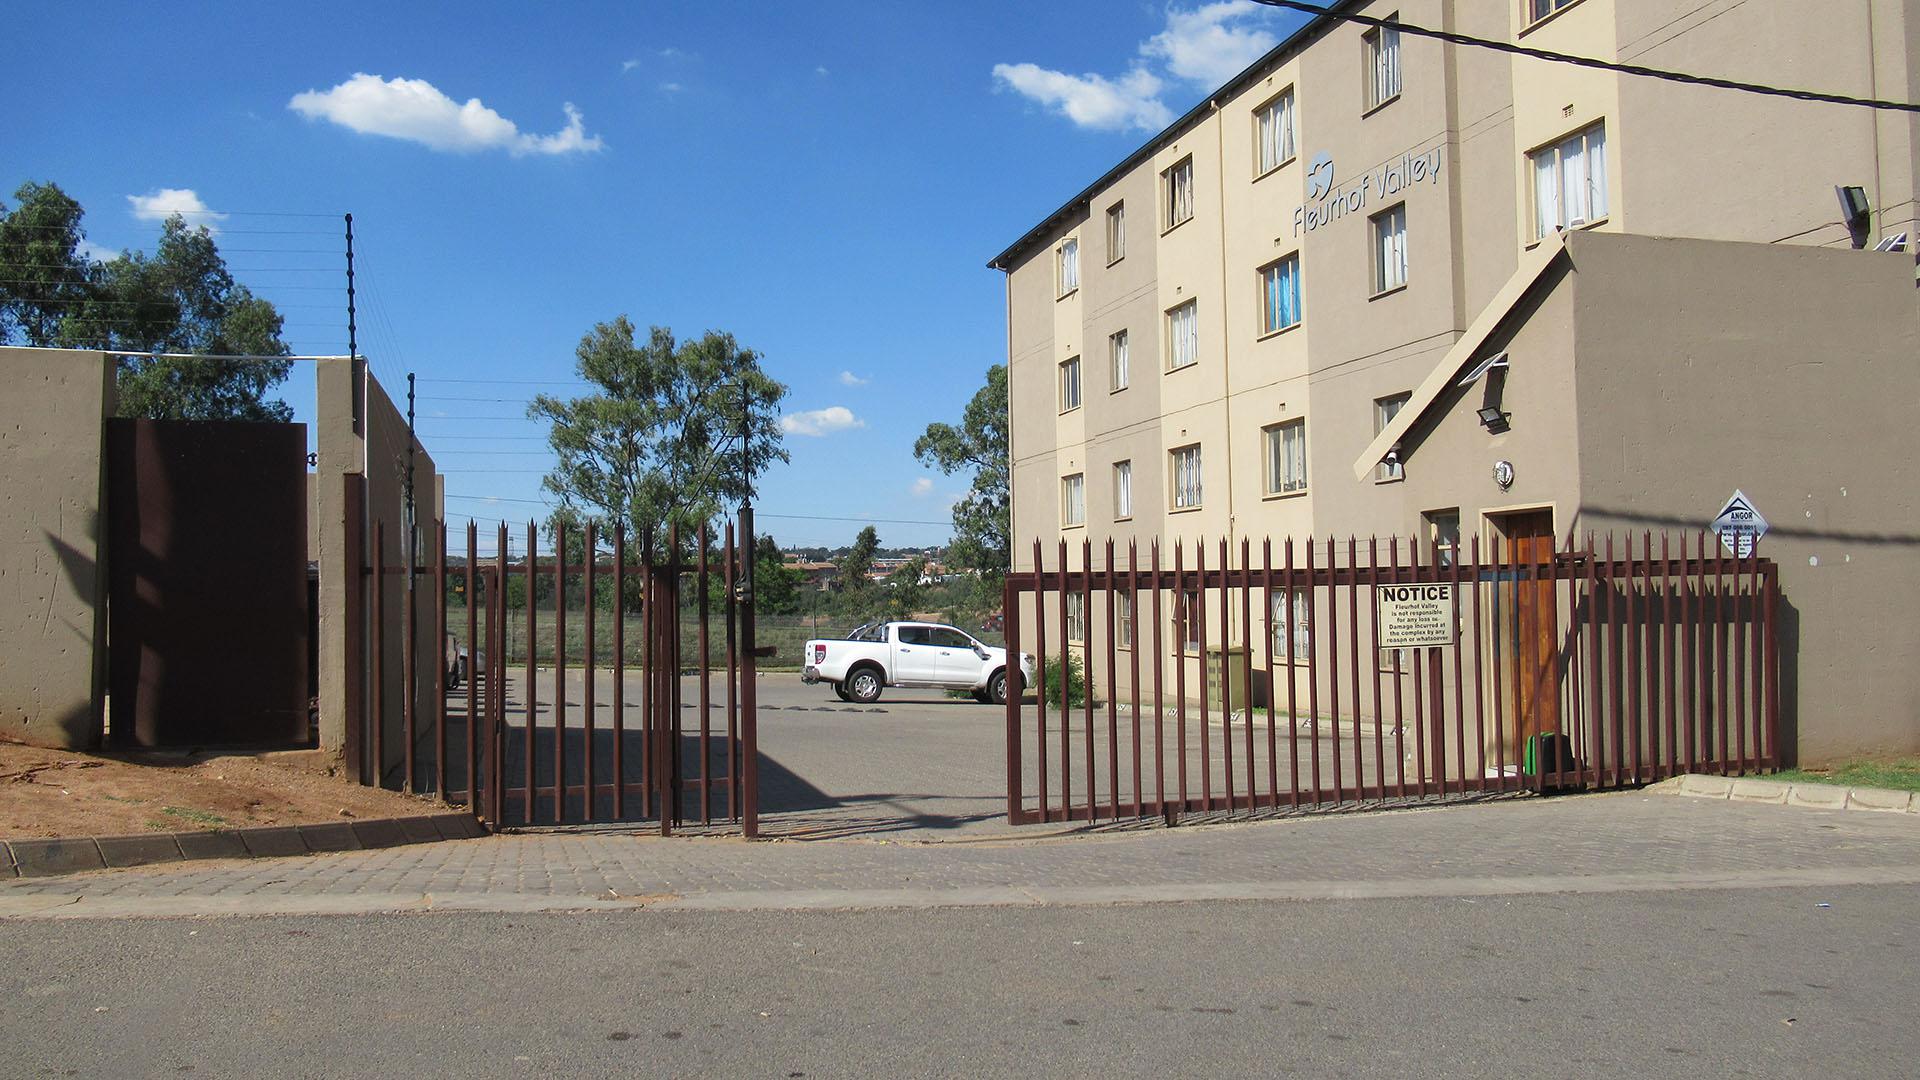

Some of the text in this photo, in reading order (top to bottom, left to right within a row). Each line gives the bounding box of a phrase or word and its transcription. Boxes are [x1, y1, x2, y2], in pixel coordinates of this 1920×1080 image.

[1294, 149, 1441, 237] Fleurhof Valley
[1384, 587, 1448, 602] NOTICE
